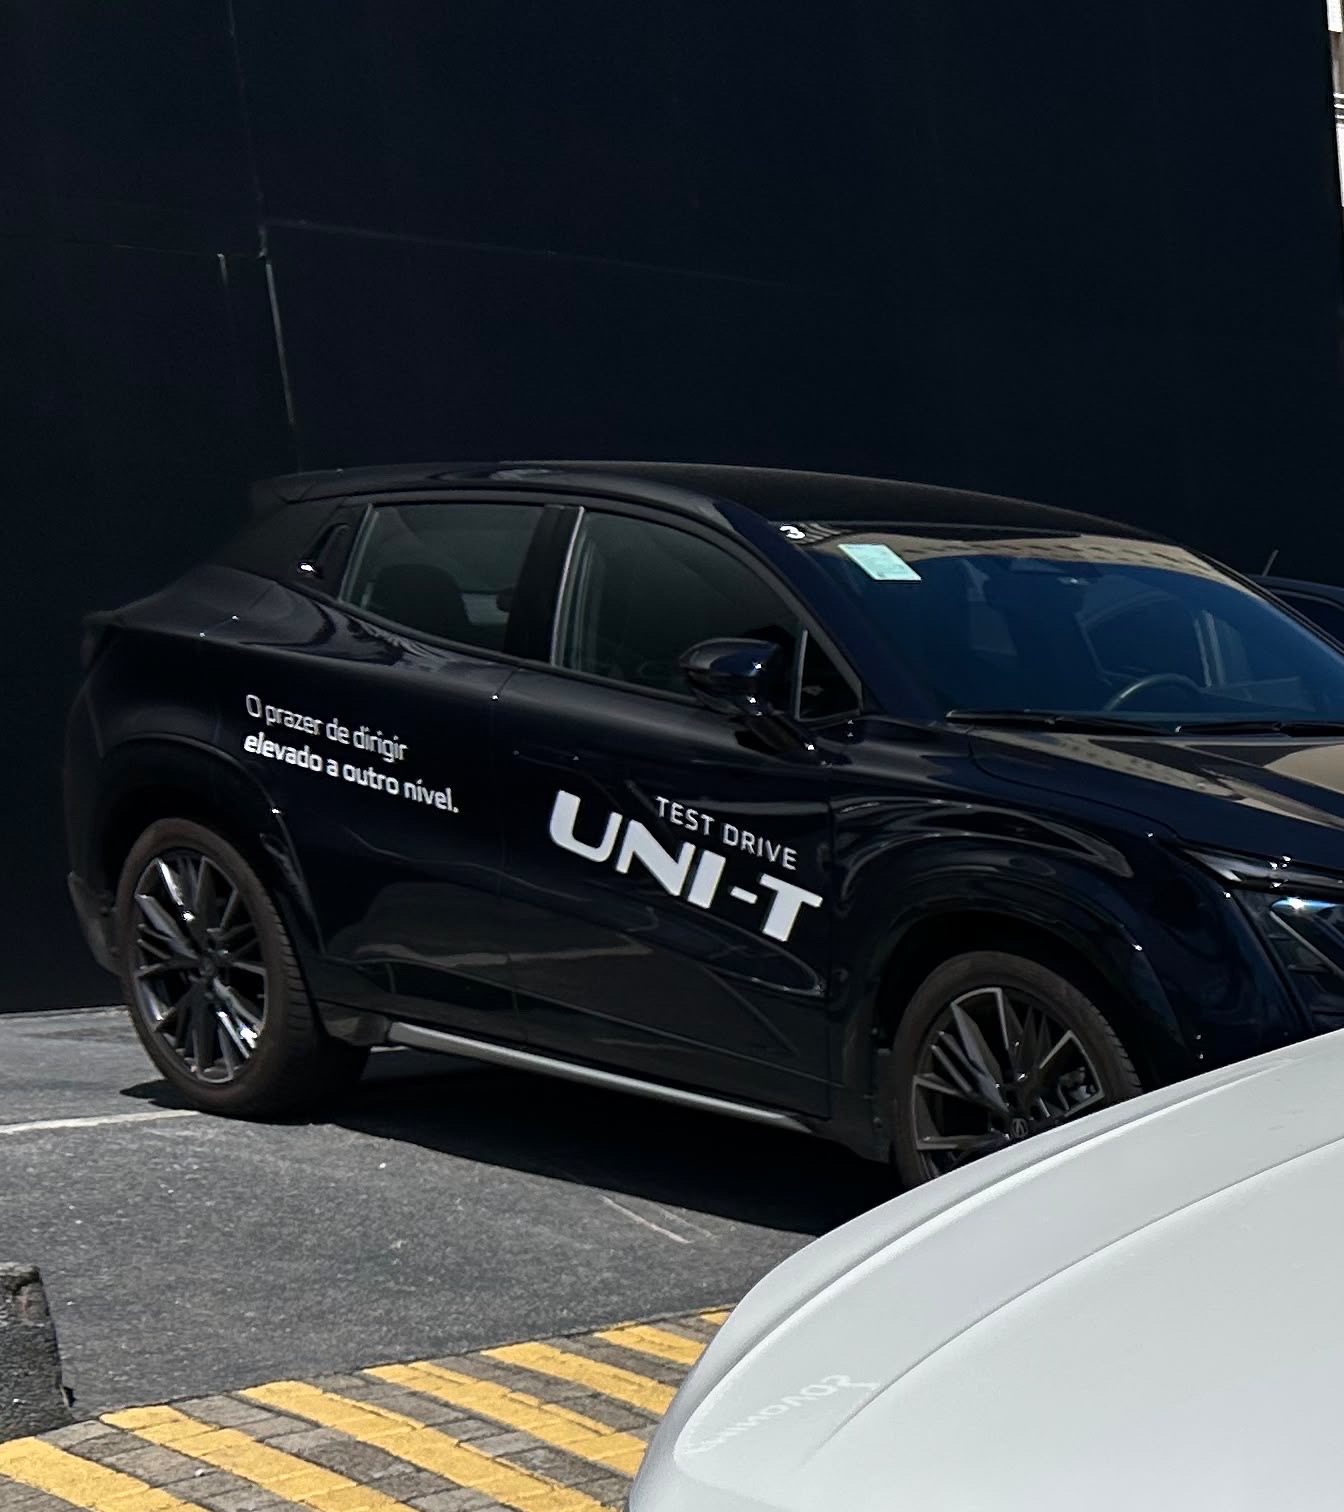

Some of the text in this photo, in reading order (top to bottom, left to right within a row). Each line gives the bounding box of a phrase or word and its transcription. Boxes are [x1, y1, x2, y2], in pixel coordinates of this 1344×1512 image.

[243, 731, 323, 772] elevado
[326, 758, 339, 777] a
[342, 763, 400, 795] outro
[245, 694, 408, 763] O prazer de dirigir
[550, 789, 824, 942] UNI-T
[656, 796, 799, 871] TEST DRIVE
